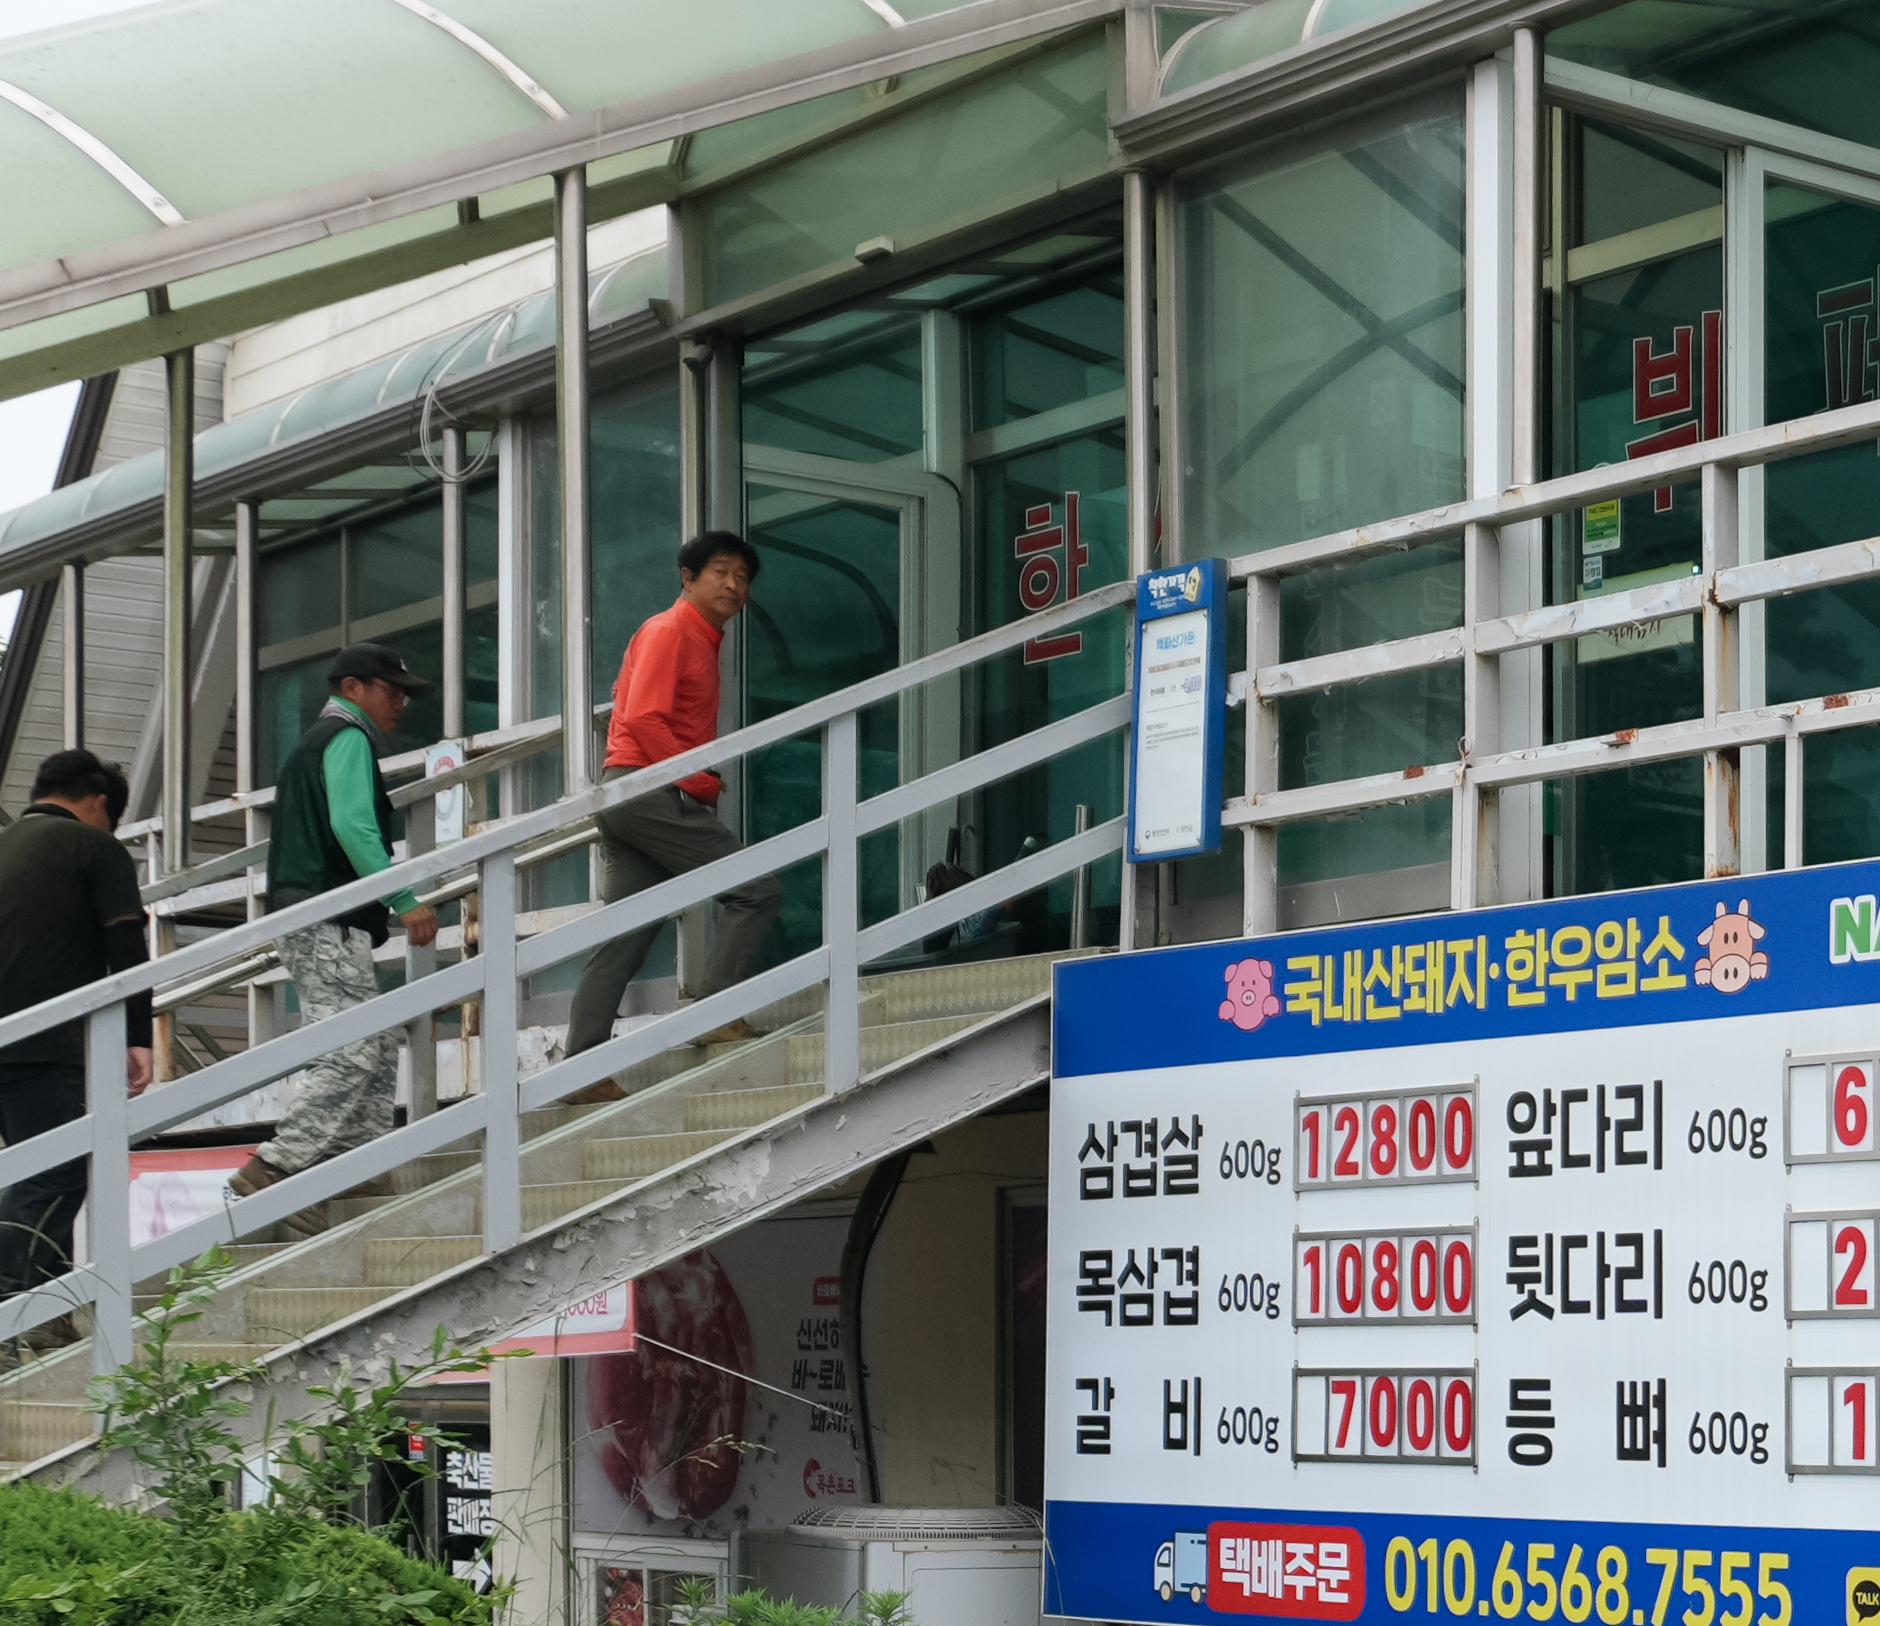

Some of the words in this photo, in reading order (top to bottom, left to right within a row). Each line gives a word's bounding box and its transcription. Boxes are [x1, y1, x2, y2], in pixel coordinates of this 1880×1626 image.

[1077, 1114, 1203, 1200] 삼겹살
[1220, 1139, 1281, 1186] 600g
[1302, 1096, 1473, 1180] 12800
[1506, 1080, 1663, 1178] 앞다리
[1688, 1107, 1768, 1159] 600g
[1076, 1246, 1200, 1327] 목삼겹
[1218, 1272, 1280, 1320] 600g
[1302, 1240, 1473, 1315] 10800
[1506, 1228, 1663, 1321] 뒷다리
[1688, 1260, 1768, 1312] 600g
[1216, 1406, 1280, 1455] 600g
[1330, 1376, 1473, 1453] 7000
[1688, 1411, 1769, 1465] 600g
[1219, 1536, 1350, 1604] 택배주문
[1856, 1592, 1880, 1606] TALK
